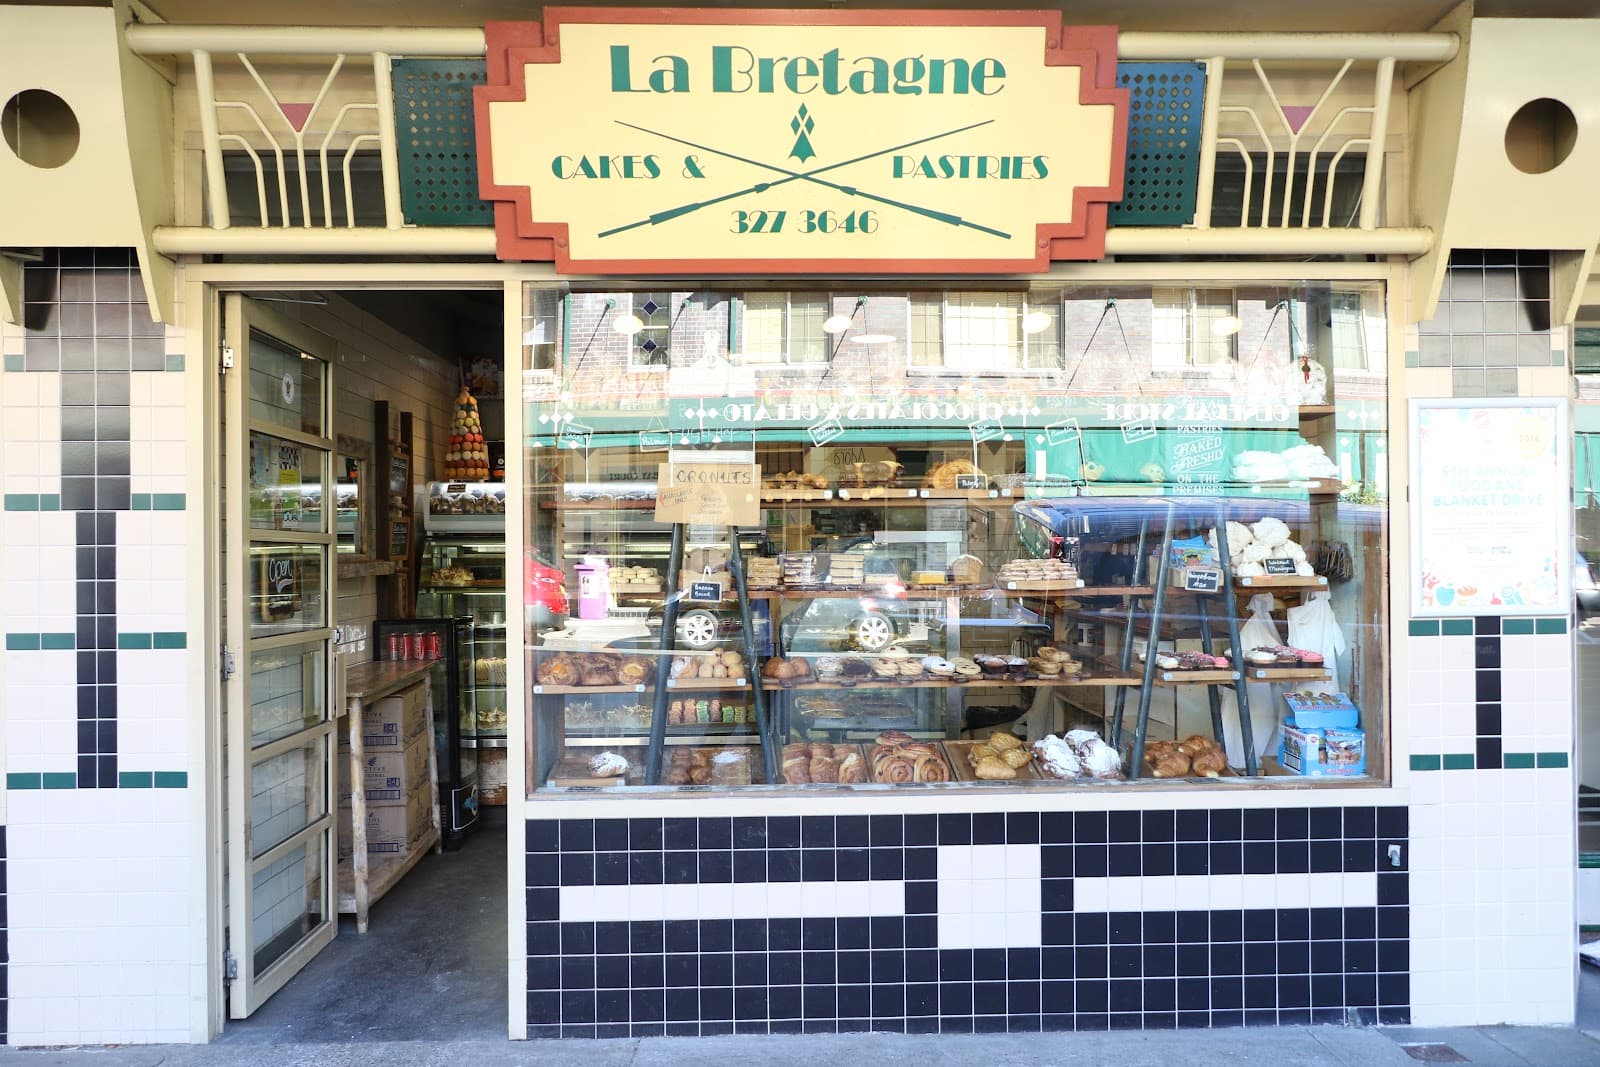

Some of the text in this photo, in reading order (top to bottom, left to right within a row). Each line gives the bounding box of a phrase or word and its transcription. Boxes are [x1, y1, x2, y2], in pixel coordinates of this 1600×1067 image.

[609, 44, 1007, 97] La Bretagne
[551, 154, 706, 180] CAKES &
[892, 154, 1049, 180] PASTRIES
[729, 210, 879, 234] 327 3646
[1177, 424, 1224, 434] PASTRIES
[1169, 446, 1226, 474] FRESHLY
[1173, 437, 1222, 460] BAKED
[677, 470, 751, 485] CRONUTS
[1177, 474, 1218, 483] ON THE
[1172, 485, 1224, 496] PREMISES
[1433, 494, 1545, 507] BLANKET DRIVE
